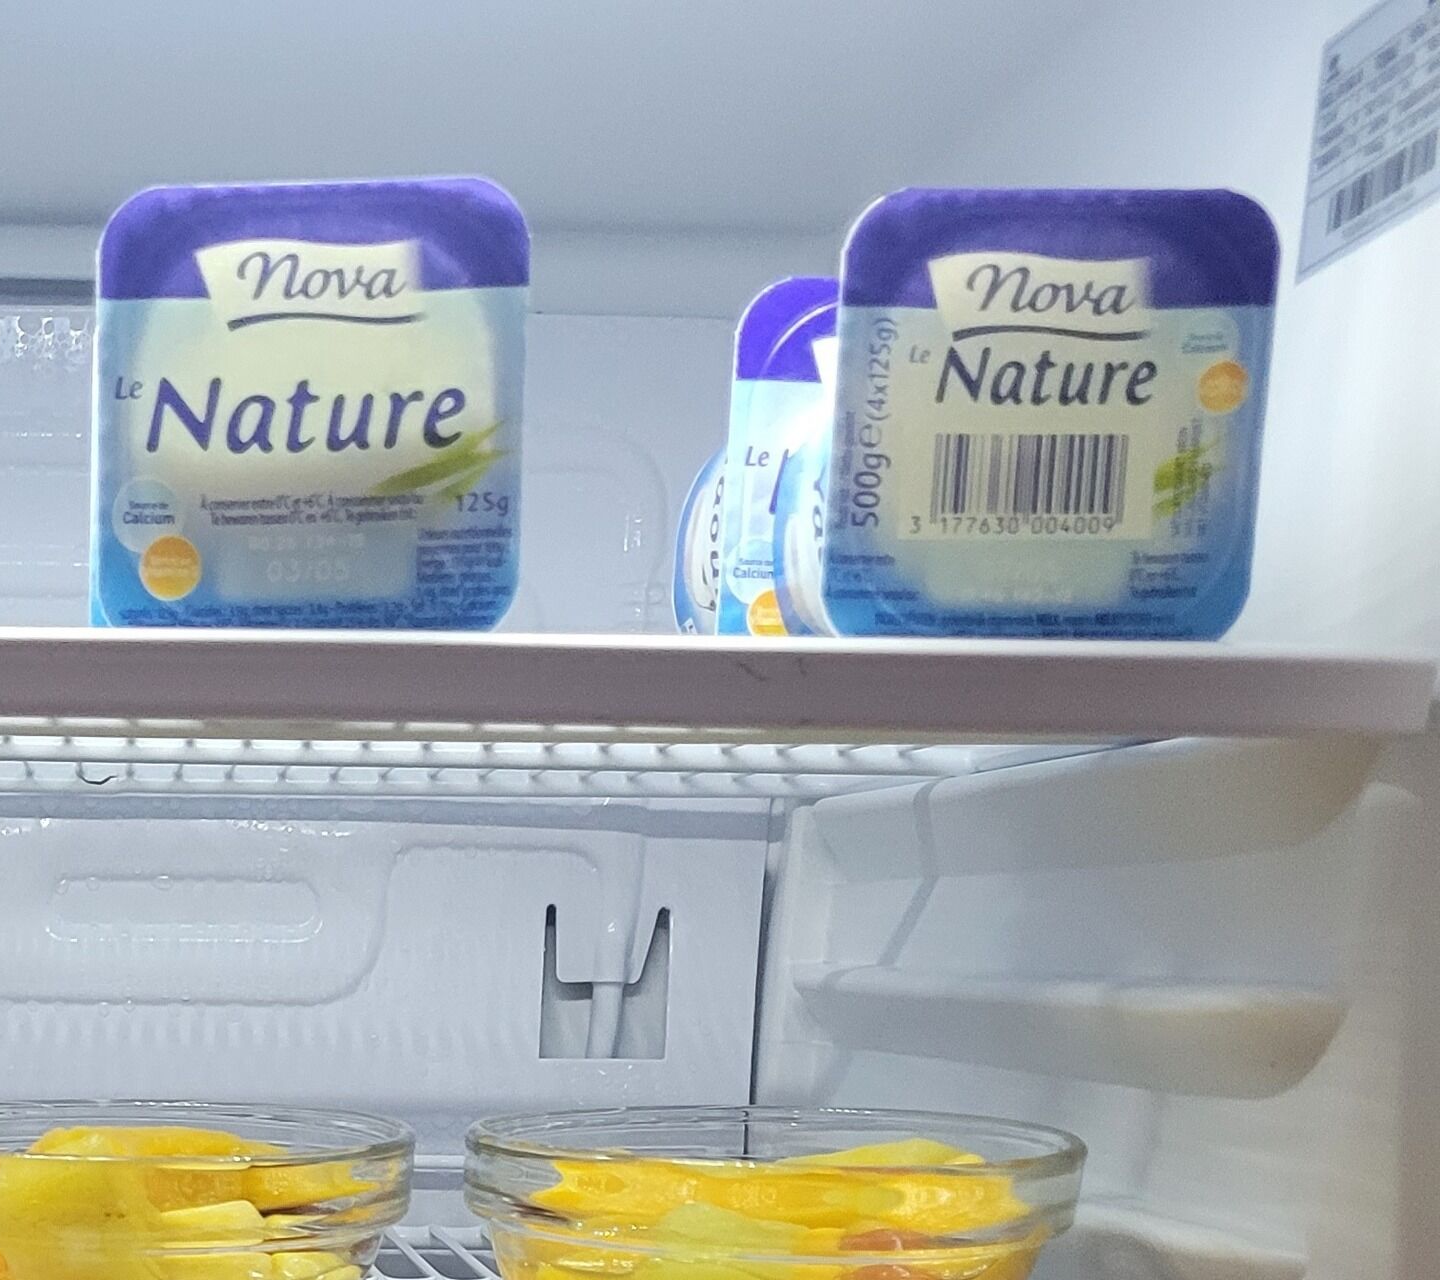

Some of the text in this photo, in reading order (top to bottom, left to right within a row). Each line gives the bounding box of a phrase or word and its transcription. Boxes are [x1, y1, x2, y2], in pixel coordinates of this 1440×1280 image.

[237, 251, 407, 301] Nova
[967, 264, 1133, 317] Nova
[909, 344, 930, 366] Le
[116, 376, 143, 400] Le
[936, 346, 1157, 409] Nature
[146, 377, 467, 455] Nature
[744, 446, 770, 468] Le
[456, 491, 509, 516] 125g
[122, 510, 175, 526] Calcium
[909, 515, 1113, 535] 3 177630 004009
